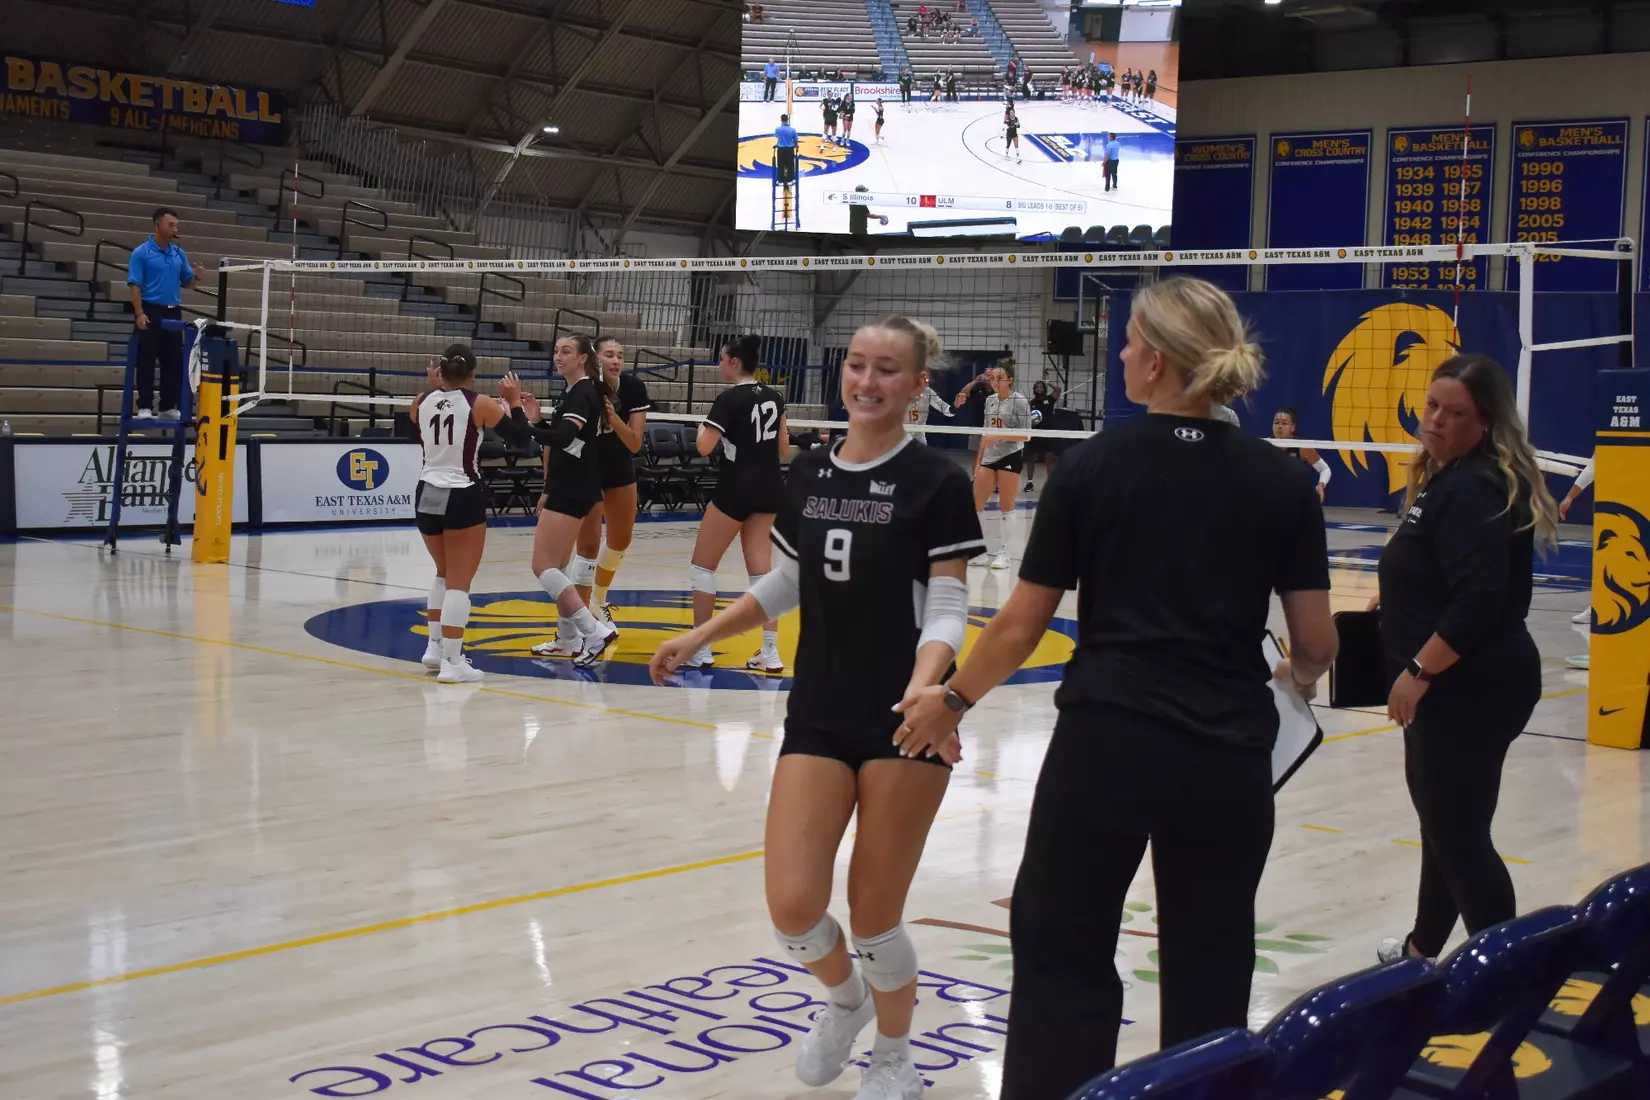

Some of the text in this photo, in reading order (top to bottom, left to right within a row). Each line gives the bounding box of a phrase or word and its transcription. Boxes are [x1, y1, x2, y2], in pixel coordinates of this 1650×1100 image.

[5, 56, 281, 123] BASKETBALL
[110, 107, 119, 127] 9
[1560, 127, 1603, 137] MEN'S
[1312, 139, 1350, 149] MEN'S
[1412, 140, 1490, 152] BASKETBALL
[1539, 136, 1623, 147] BASKETBALL
[1192, 144, 1244, 153] WOMEN'S
[1295, 146, 1365, 158] CROSS COUNTRY
[1396, 166, 1435, 180] 1934
[1521, 162, 1564, 176] 1990
[1396, 183, 1434, 196] 1939
[1520, 179, 1562, 193] 1996
[850, 194, 874, 202] Illinois
[1519, 196, 1561, 210] 1998
[1395, 200, 1433, 213] 1940
[1394, 217, 1432, 229] 1942
[1518, 214, 1564, 228] 2005
[1393, 233, 1431, 246] 1948
[1517, 231, 1558, 242] 2015
[1180, 252, 1197, 260] EAST
[1200, 252, 1223, 260] TEXAS
[1286, 250, 1311, 258] TEXAS
[1354, 249, 1372, 257] EAST
[1376, 248, 1402, 257] TEXAS
[1392, 267, 1477, 280] 1953 1978
[751, 400, 778, 443] 12
[908, 411, 918, 421] 15
[1610, 416, 1640, 427] A&M
[429, 413, 454, 445] 11
[991, 418, 1002, 428] 20
[78, 446, 195, 483] Aliane
[350, 452, 378, 488] ET
[315, 494, 410, 506] EAST TEXAS A&M
[802, 496, 894, 524] SALUKIS
[824, 528, 852, 582] 9
[289, 952, 862, 1097] ealthcare
